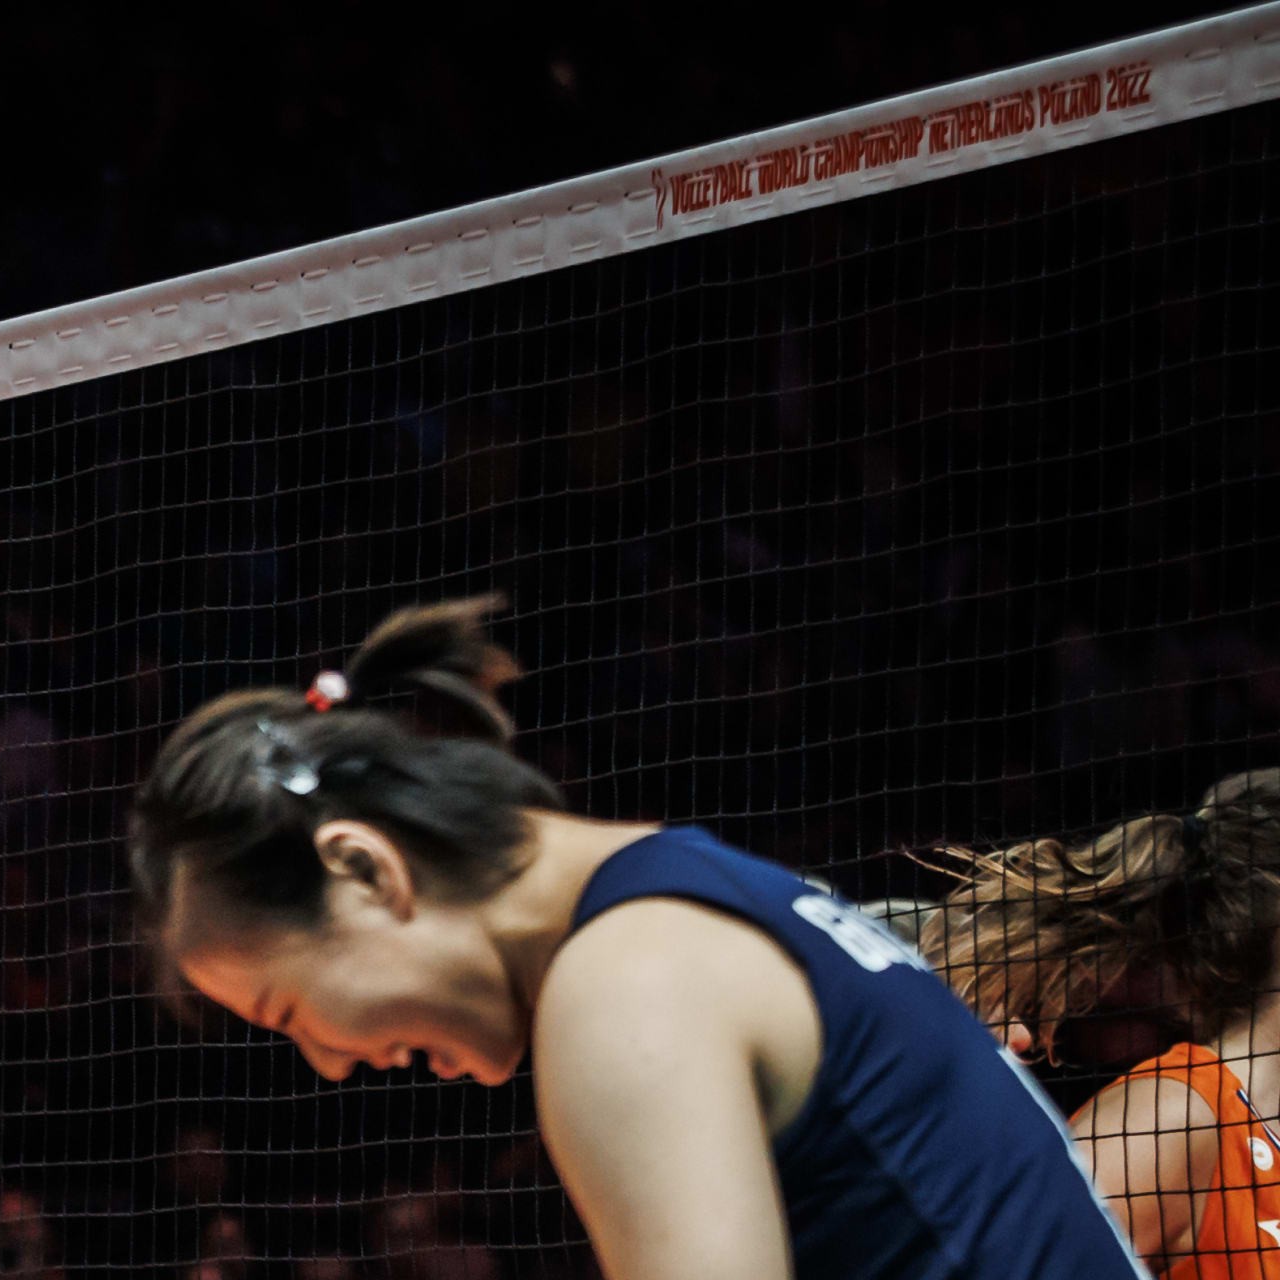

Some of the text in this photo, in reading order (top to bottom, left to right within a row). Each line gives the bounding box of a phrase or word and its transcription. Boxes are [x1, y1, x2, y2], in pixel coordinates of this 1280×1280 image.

[670, 59, 1153, 216] VOLLEYBALL WORLD CHAMPIONSHIP NETHERLANDS POLAND 2022
